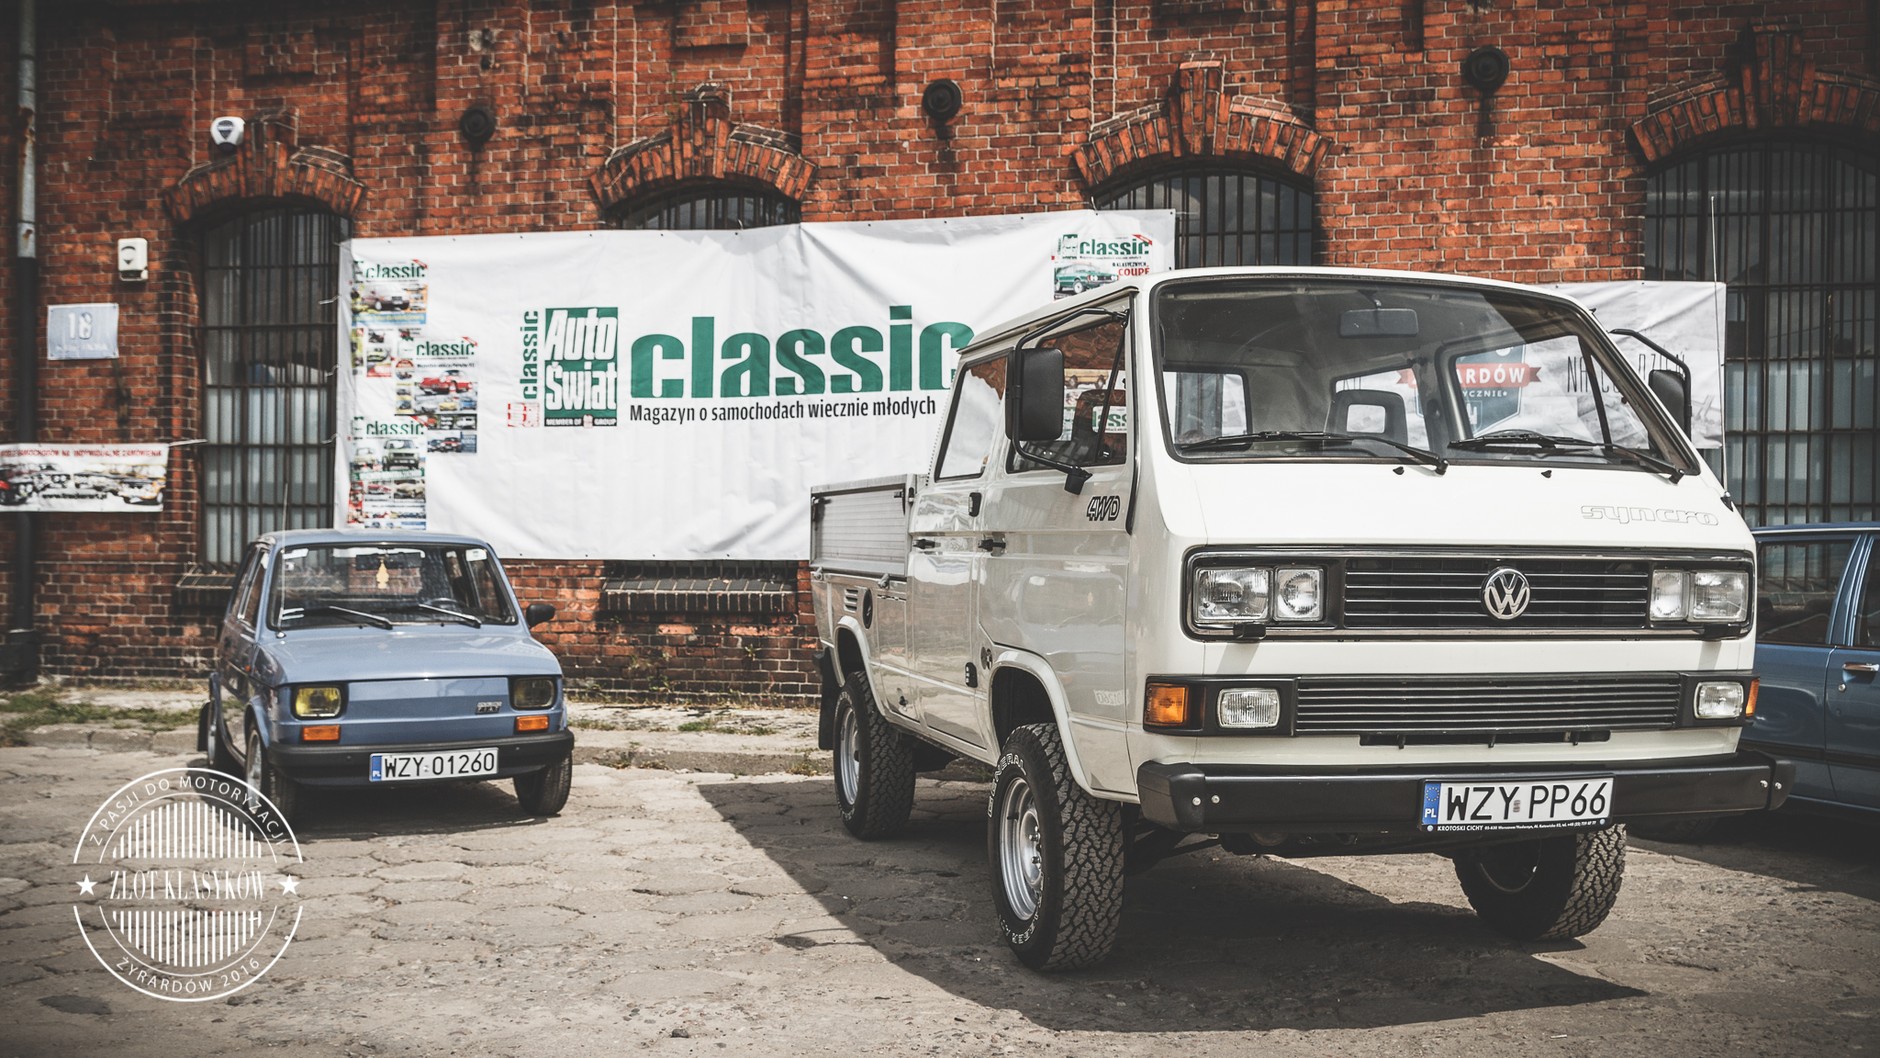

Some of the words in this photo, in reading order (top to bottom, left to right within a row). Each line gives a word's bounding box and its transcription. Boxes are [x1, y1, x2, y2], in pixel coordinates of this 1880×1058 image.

[1080, 239, 1149, 255] classic
[365, 263, 425, 278] classic
[545, 308, 618, 360] Auto
[416, 341, 474, 356] classic
[520, 311, 538, 399] classic
[630, 305, 975, 398] classic
[546, 361, 617, 410] Świat
[1462, 390, 1503, 398] YCZNIE
[629, 404, 695, 425] Magazyn
[699, 407, 708, 421] o
[711, 399, 804, 421] samochodach
[808, 398, 869, 419] wiecznie
[873, 395, 936, 420] młodych
[366, 420, 424, 435] classic
[1086, 495, 1120, 521] 4WD
[1581, 505, 1719, 526] syncro
[384, 756, 424, 778] WZY
[432, 752, 494, 775] 01260
[1424, 808, 1437, 818] PL
[1447, 786, 1520, 821] WZY
[1528, 782, 1607, 819] PP66
